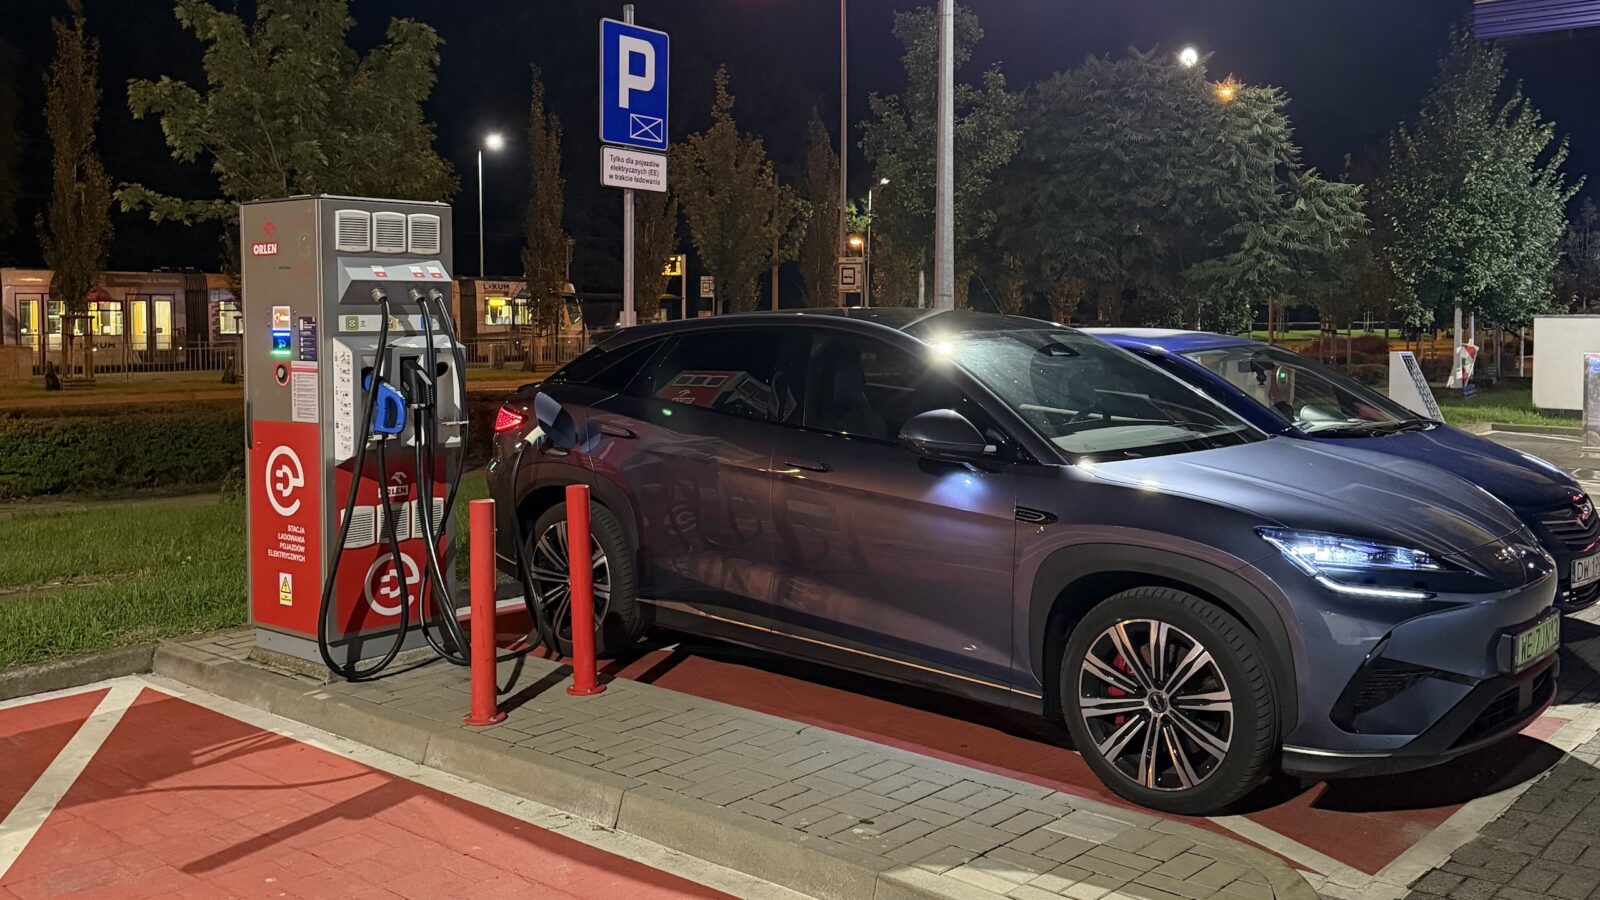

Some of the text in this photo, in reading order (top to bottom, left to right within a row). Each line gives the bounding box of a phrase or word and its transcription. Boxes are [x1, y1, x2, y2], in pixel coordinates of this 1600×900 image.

[618, 34, 655, 109] P
[610, 154, 660, 168] Tylko dla pojazdów
[610, 164, 660, 177] elektrycznych (EE)
[615, 174, 633, 182] trakcie
[634, 176, 661, 185] ładowania
[253, 243, 277, 255] ORLEN
[387, 485, 408, 496] RLEN
[287, 524, 305, 534] STACJA
[277, 532, 305, 543] ŁADOWANIA
[279, 541, 305, 553] POJAZDÓW
[267, 548, 306, 562] ELEKTRYCZNYCH
[1576, 560, 1590, 580] DW
